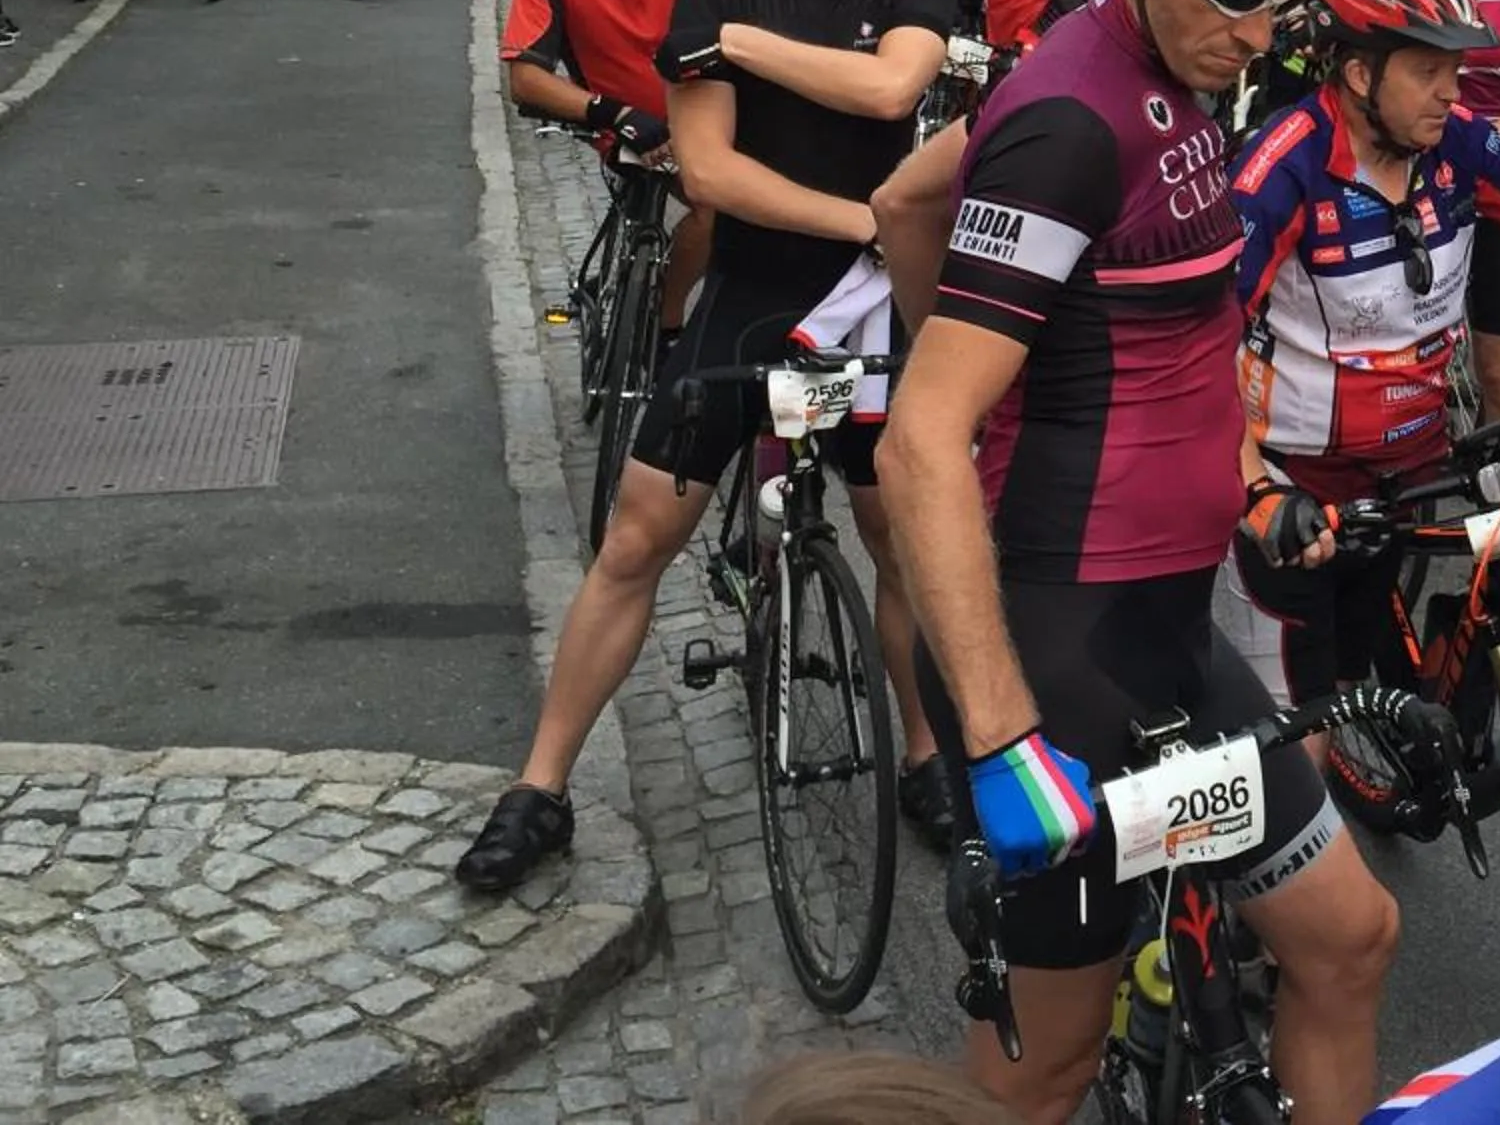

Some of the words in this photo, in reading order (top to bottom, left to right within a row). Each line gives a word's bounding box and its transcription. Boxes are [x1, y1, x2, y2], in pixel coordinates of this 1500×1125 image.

[959, 202, 1025, 244] RADDA
[963, 234, 1017, 261] CHIANTI
[804, 378, 855, 406] 2596
[1167, 775, 1250, 828] 2086
